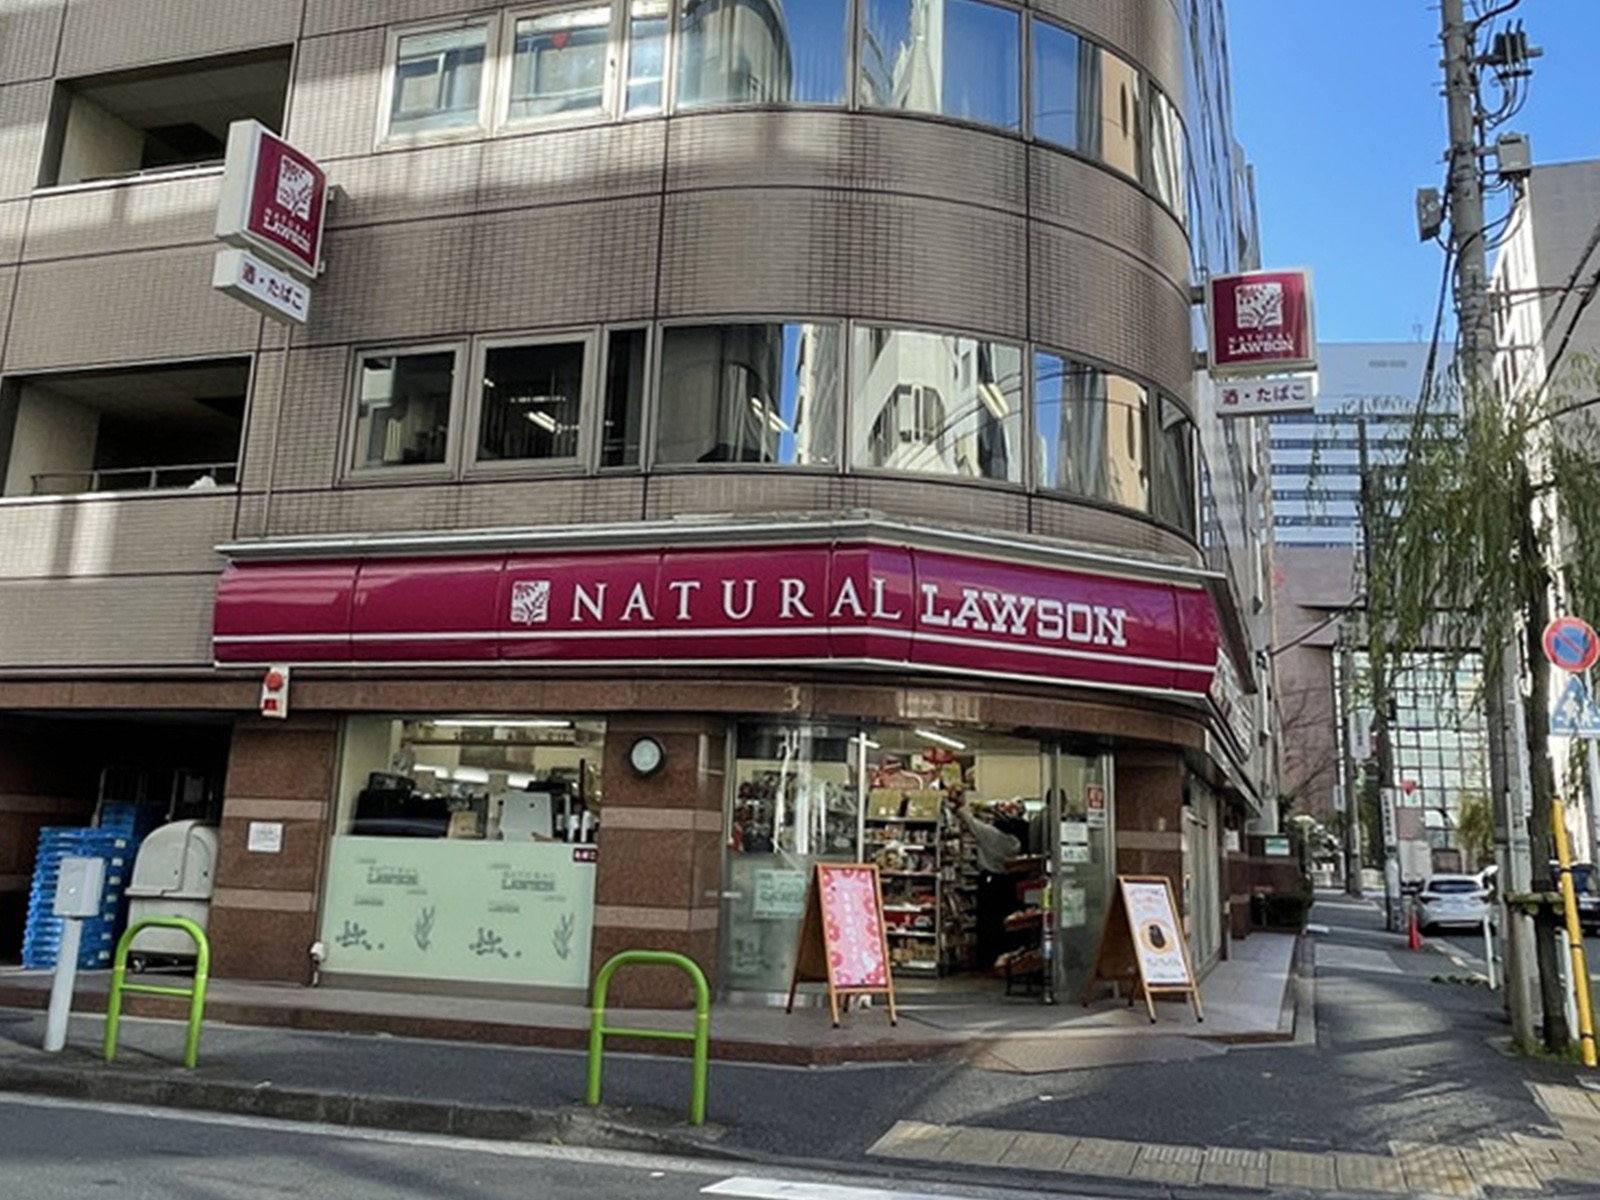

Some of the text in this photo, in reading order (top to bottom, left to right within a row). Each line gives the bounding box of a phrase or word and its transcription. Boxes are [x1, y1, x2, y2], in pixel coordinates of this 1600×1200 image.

[1228, 340, 1294, 355] LAWSON
[1223, 385, 1305, 404] 酒・たばこ
[571, 576, 1127, 648] NATURAL LAWSON
